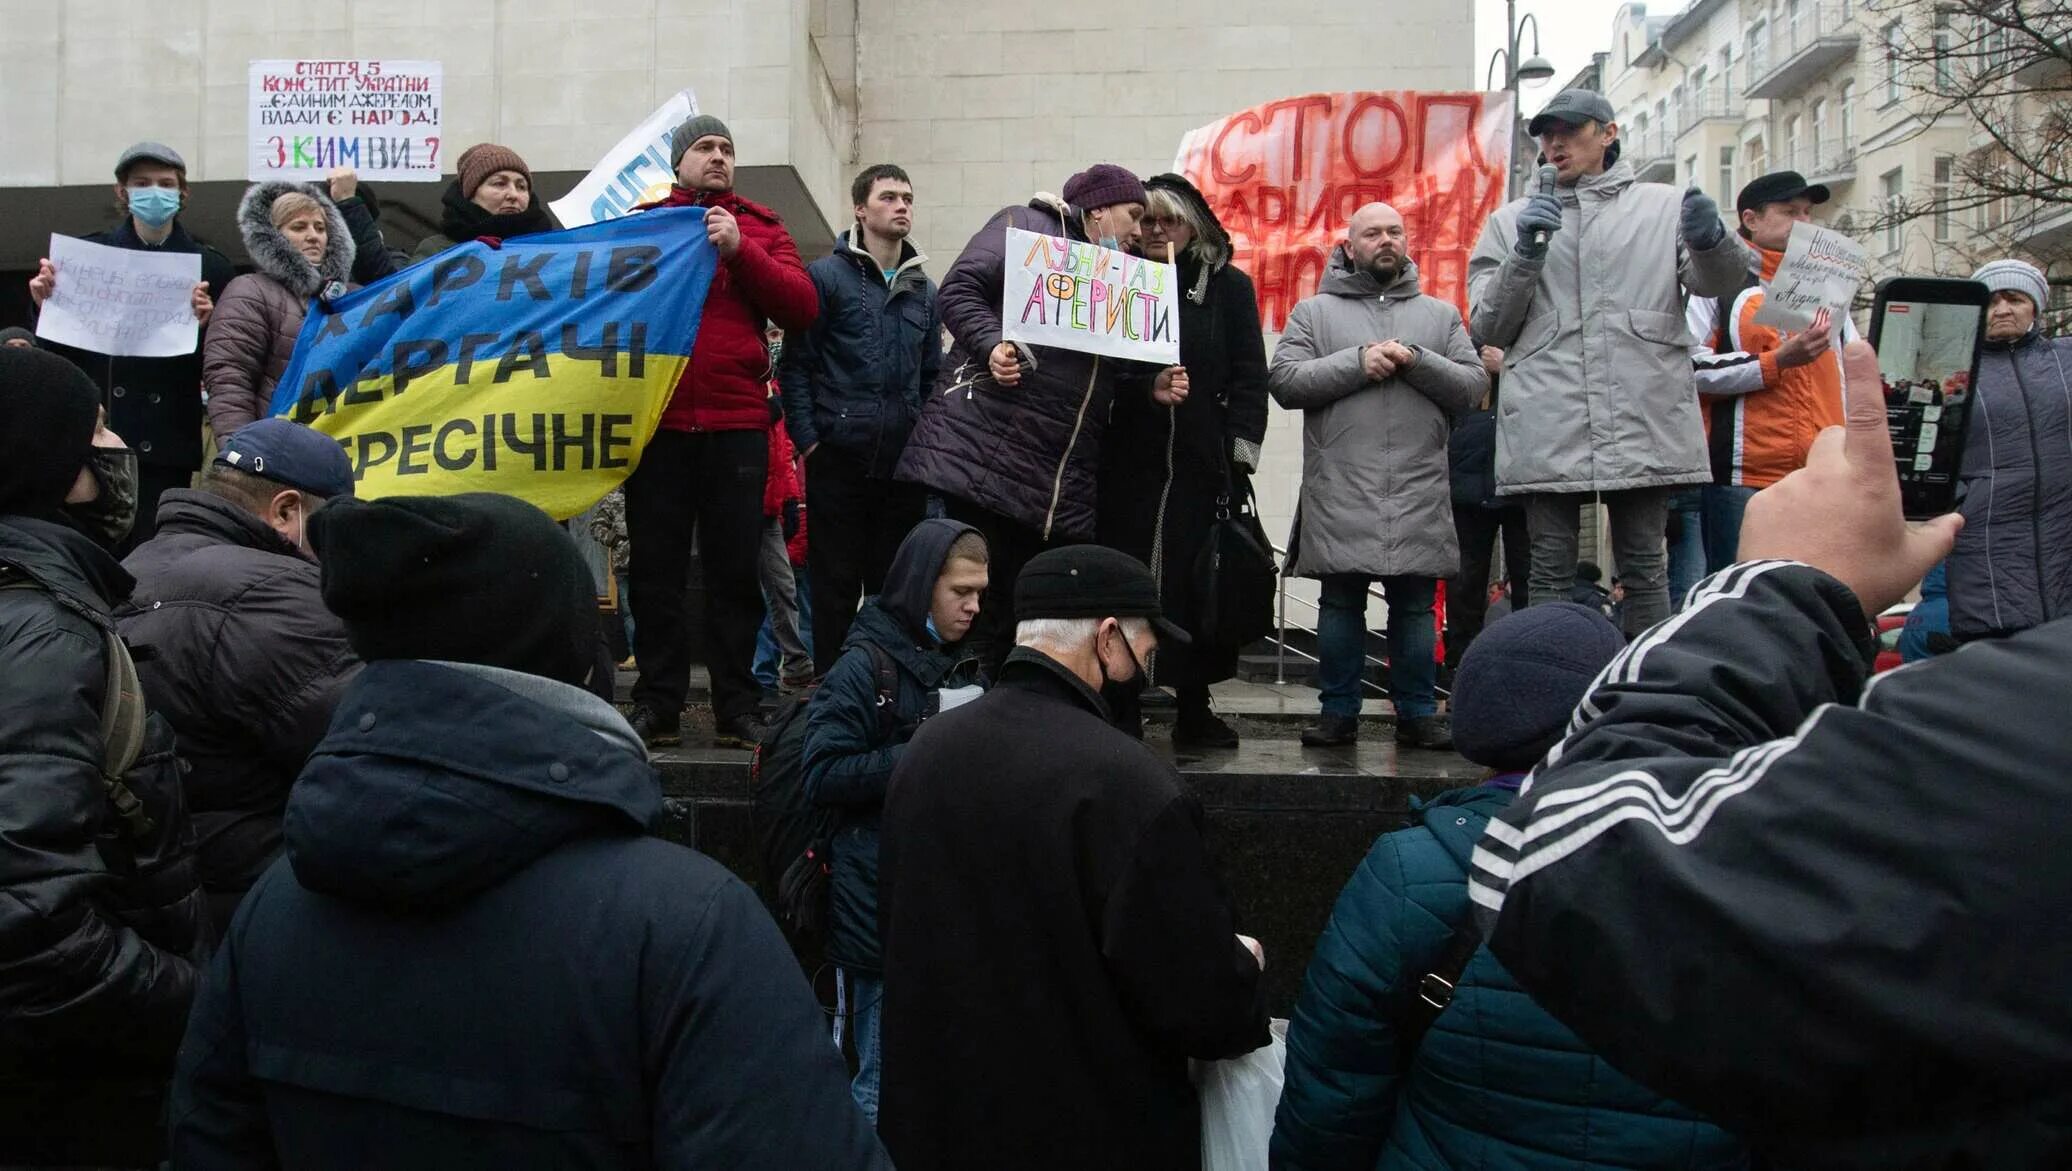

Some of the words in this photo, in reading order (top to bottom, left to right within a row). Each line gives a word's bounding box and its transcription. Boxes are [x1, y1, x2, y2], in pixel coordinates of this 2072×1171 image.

[295, 61, 359, 76] СТАТТЯ
[367, 62, 381, 76] 5
[355, 74, 429, 92] УКРАЇНИ
[262, 109, 320, 125] ВЛАДИ
[326, 109, 343, 125] Є
[351, 108, 439, 126] НАРОД!
[350, 93, 432, 109] ДЖЕРЕЛОМ
[293, 136, 360, 169] КИМ
[1212, 95, 1490, 184] СТОП
[315, 245, 663, 345] ХАРКІВ
[290, 321, 648, 425] ДЕРГАЧІ
[336, 413, 633, 482] РЕСІЧНЕ
